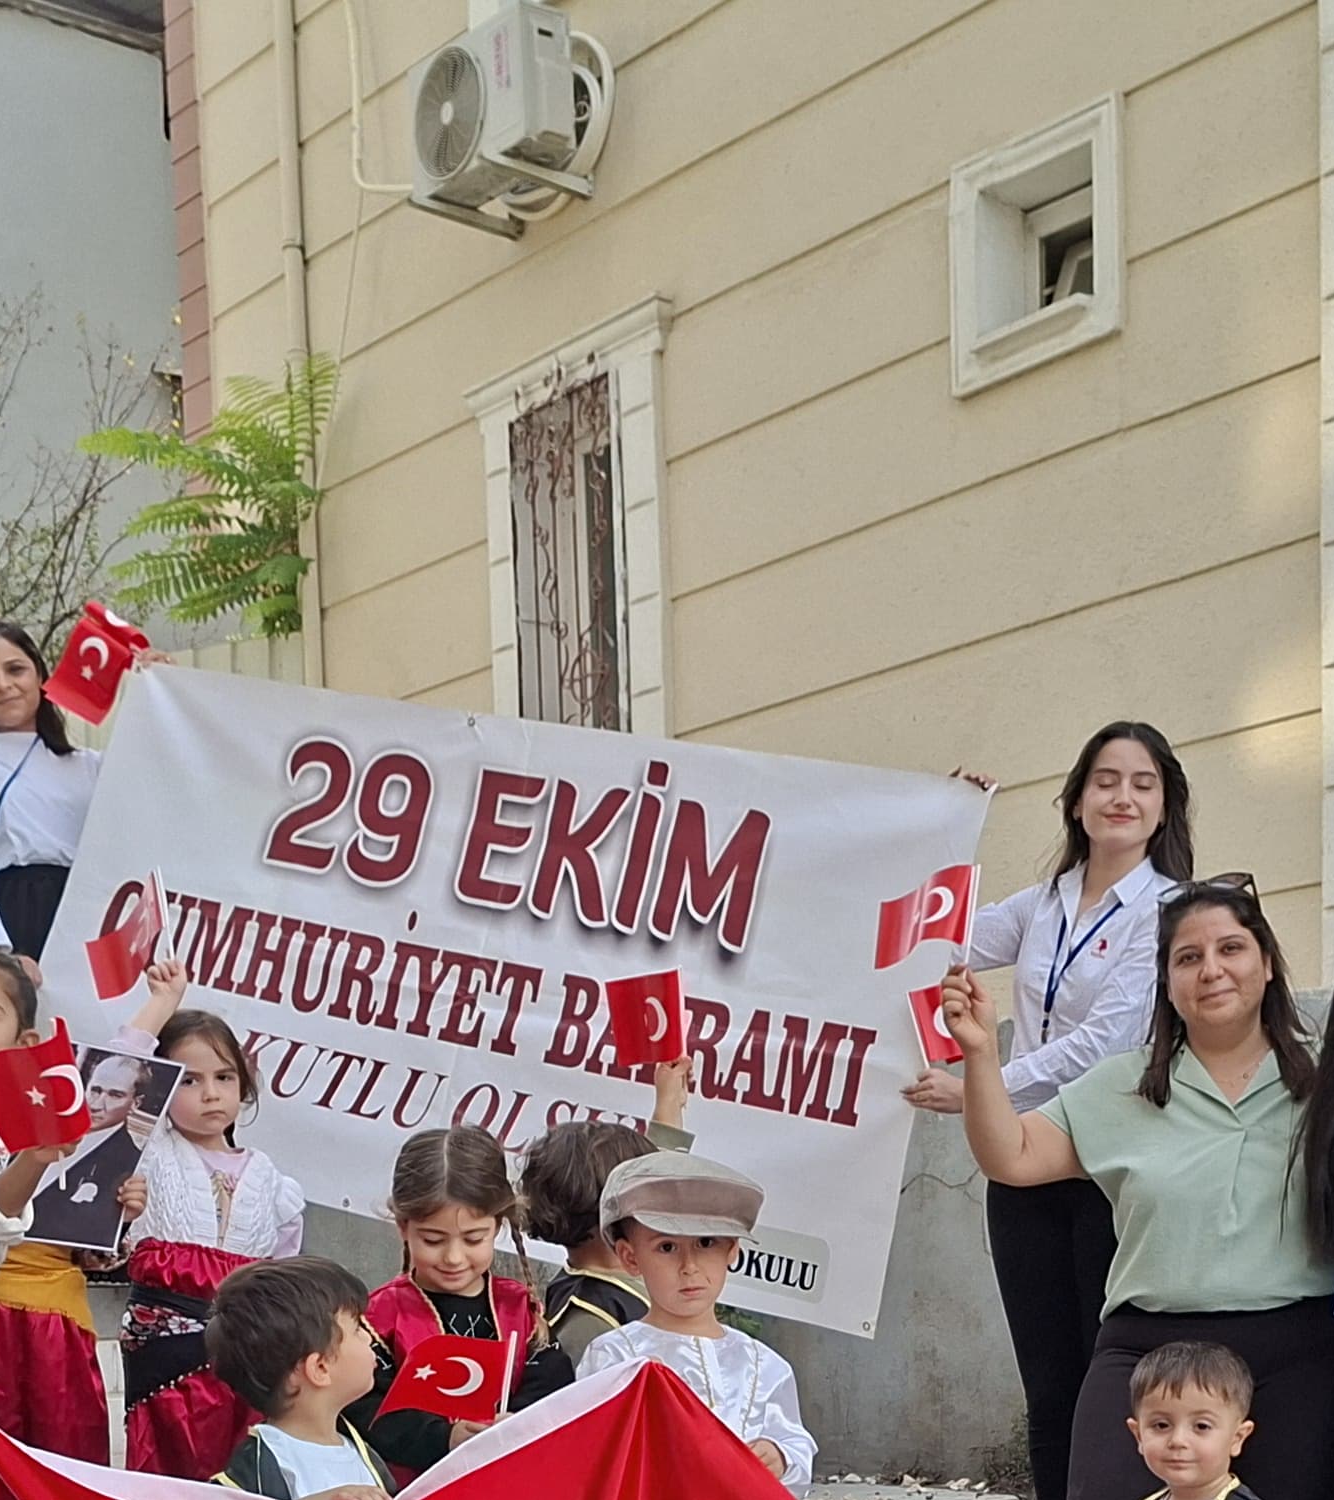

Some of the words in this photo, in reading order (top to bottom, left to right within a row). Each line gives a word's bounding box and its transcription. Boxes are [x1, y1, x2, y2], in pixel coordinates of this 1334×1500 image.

[266, 737, 433, 884] 29
[456, 758, 772, 952] EKİM
[544, 973, 876, 1126] BRAMI
